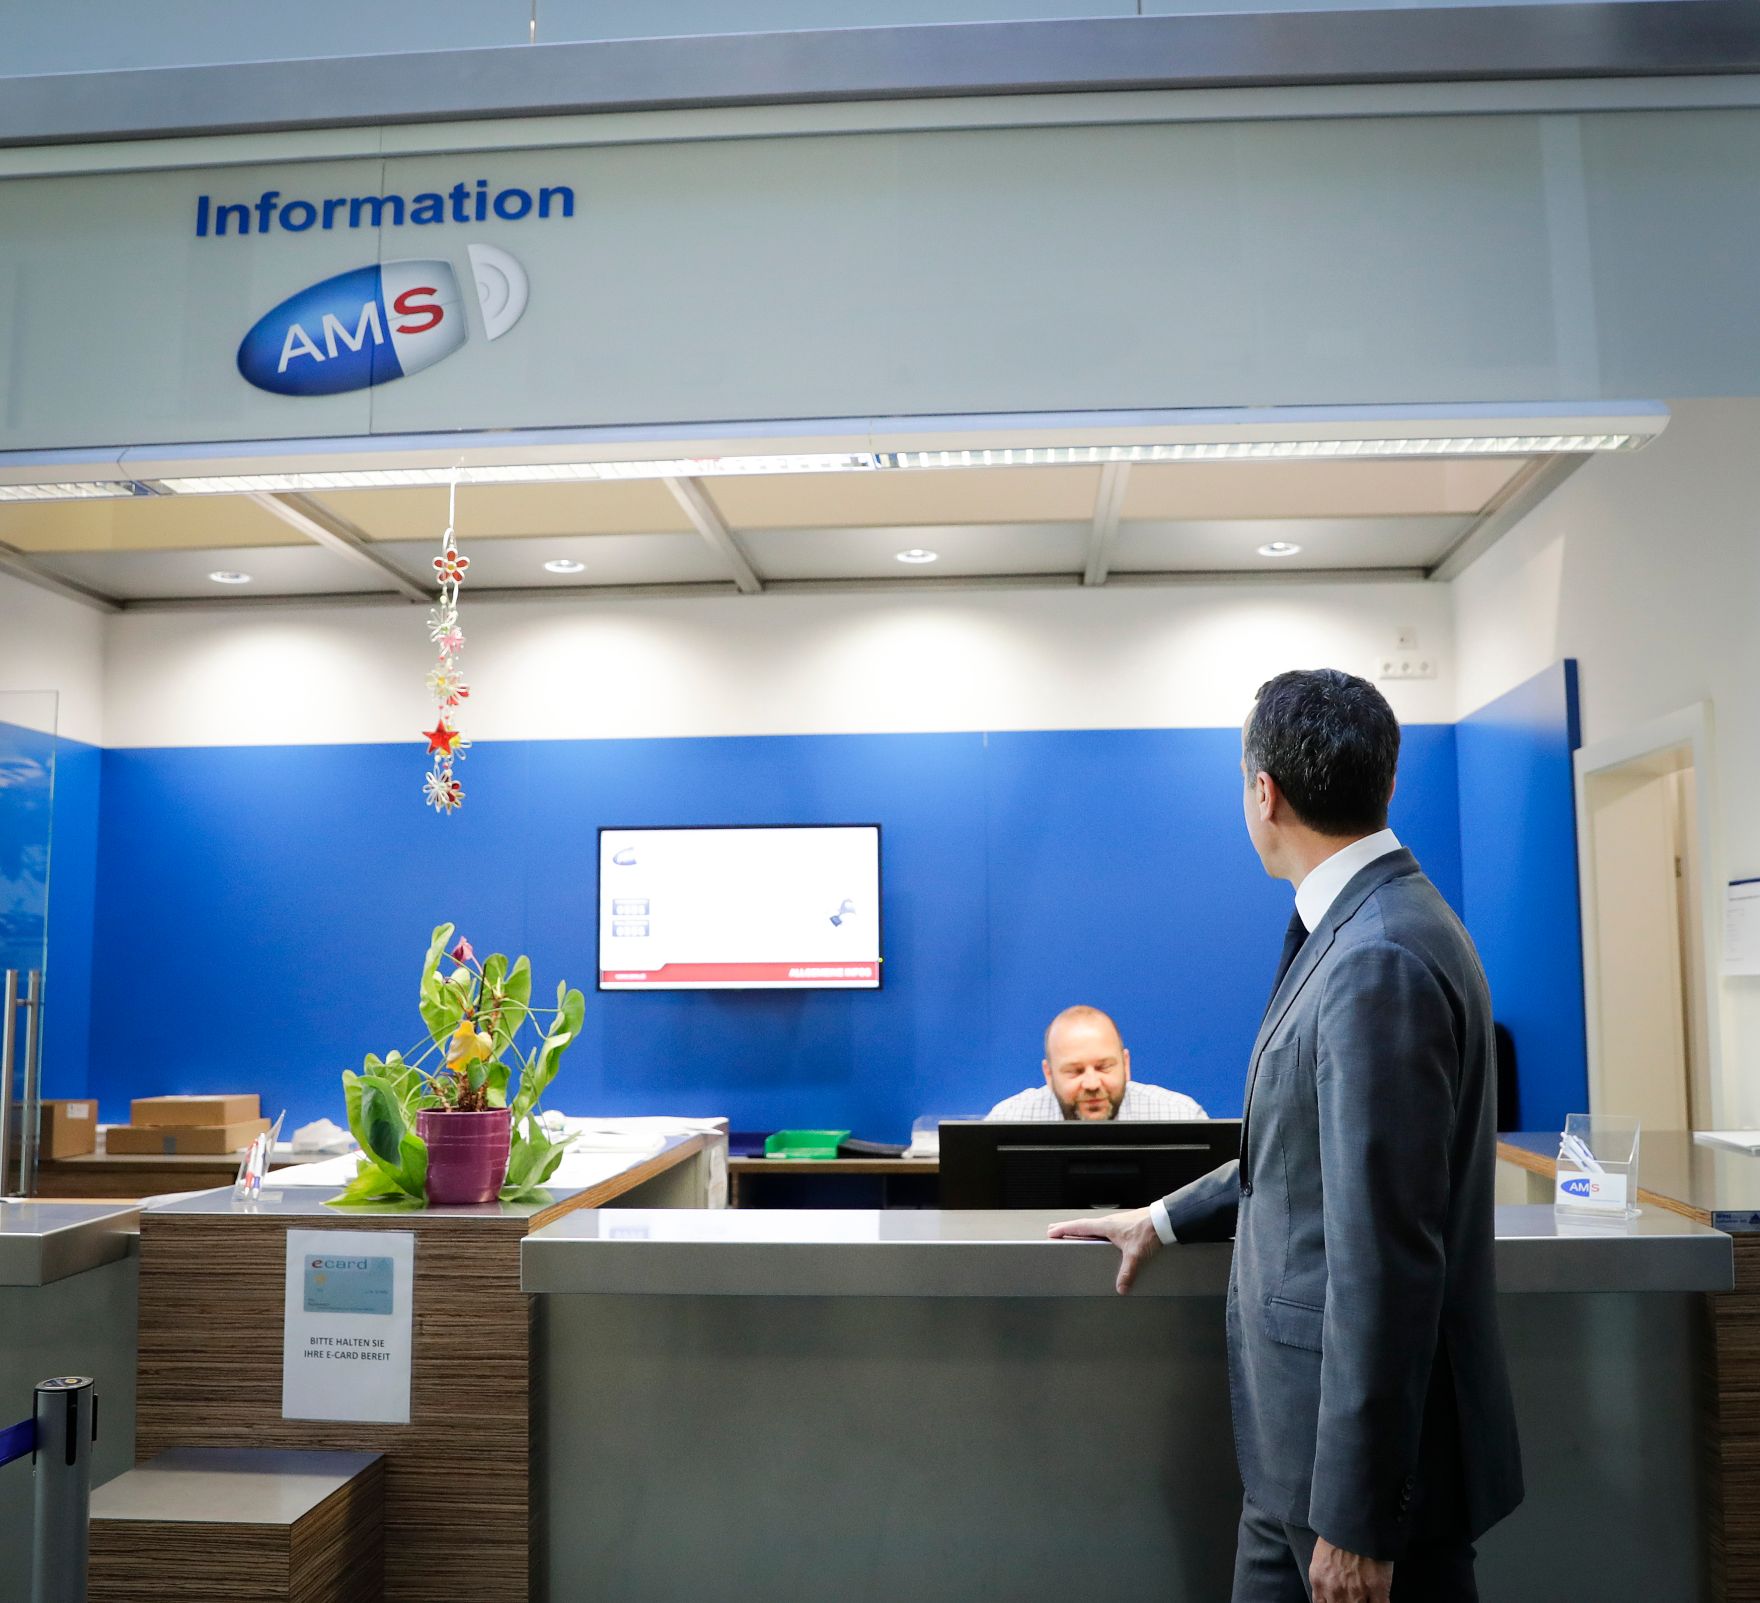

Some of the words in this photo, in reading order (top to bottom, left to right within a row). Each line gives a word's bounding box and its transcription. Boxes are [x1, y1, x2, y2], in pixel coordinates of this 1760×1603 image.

[196, 179, 575, 237] Information
[277, 286, 444, 373] AMS
[1569, 1182, 1600, 1193] AMS
[310, 1337, 334, 1346] BITTE
[336, 1338, 370, 1347] HALTEN
[304, 1350, 324, 1358] IHRE
[326, 1351, 359, 1360] E-CARD
[361, 1352, 390, 1361] BEREIT
